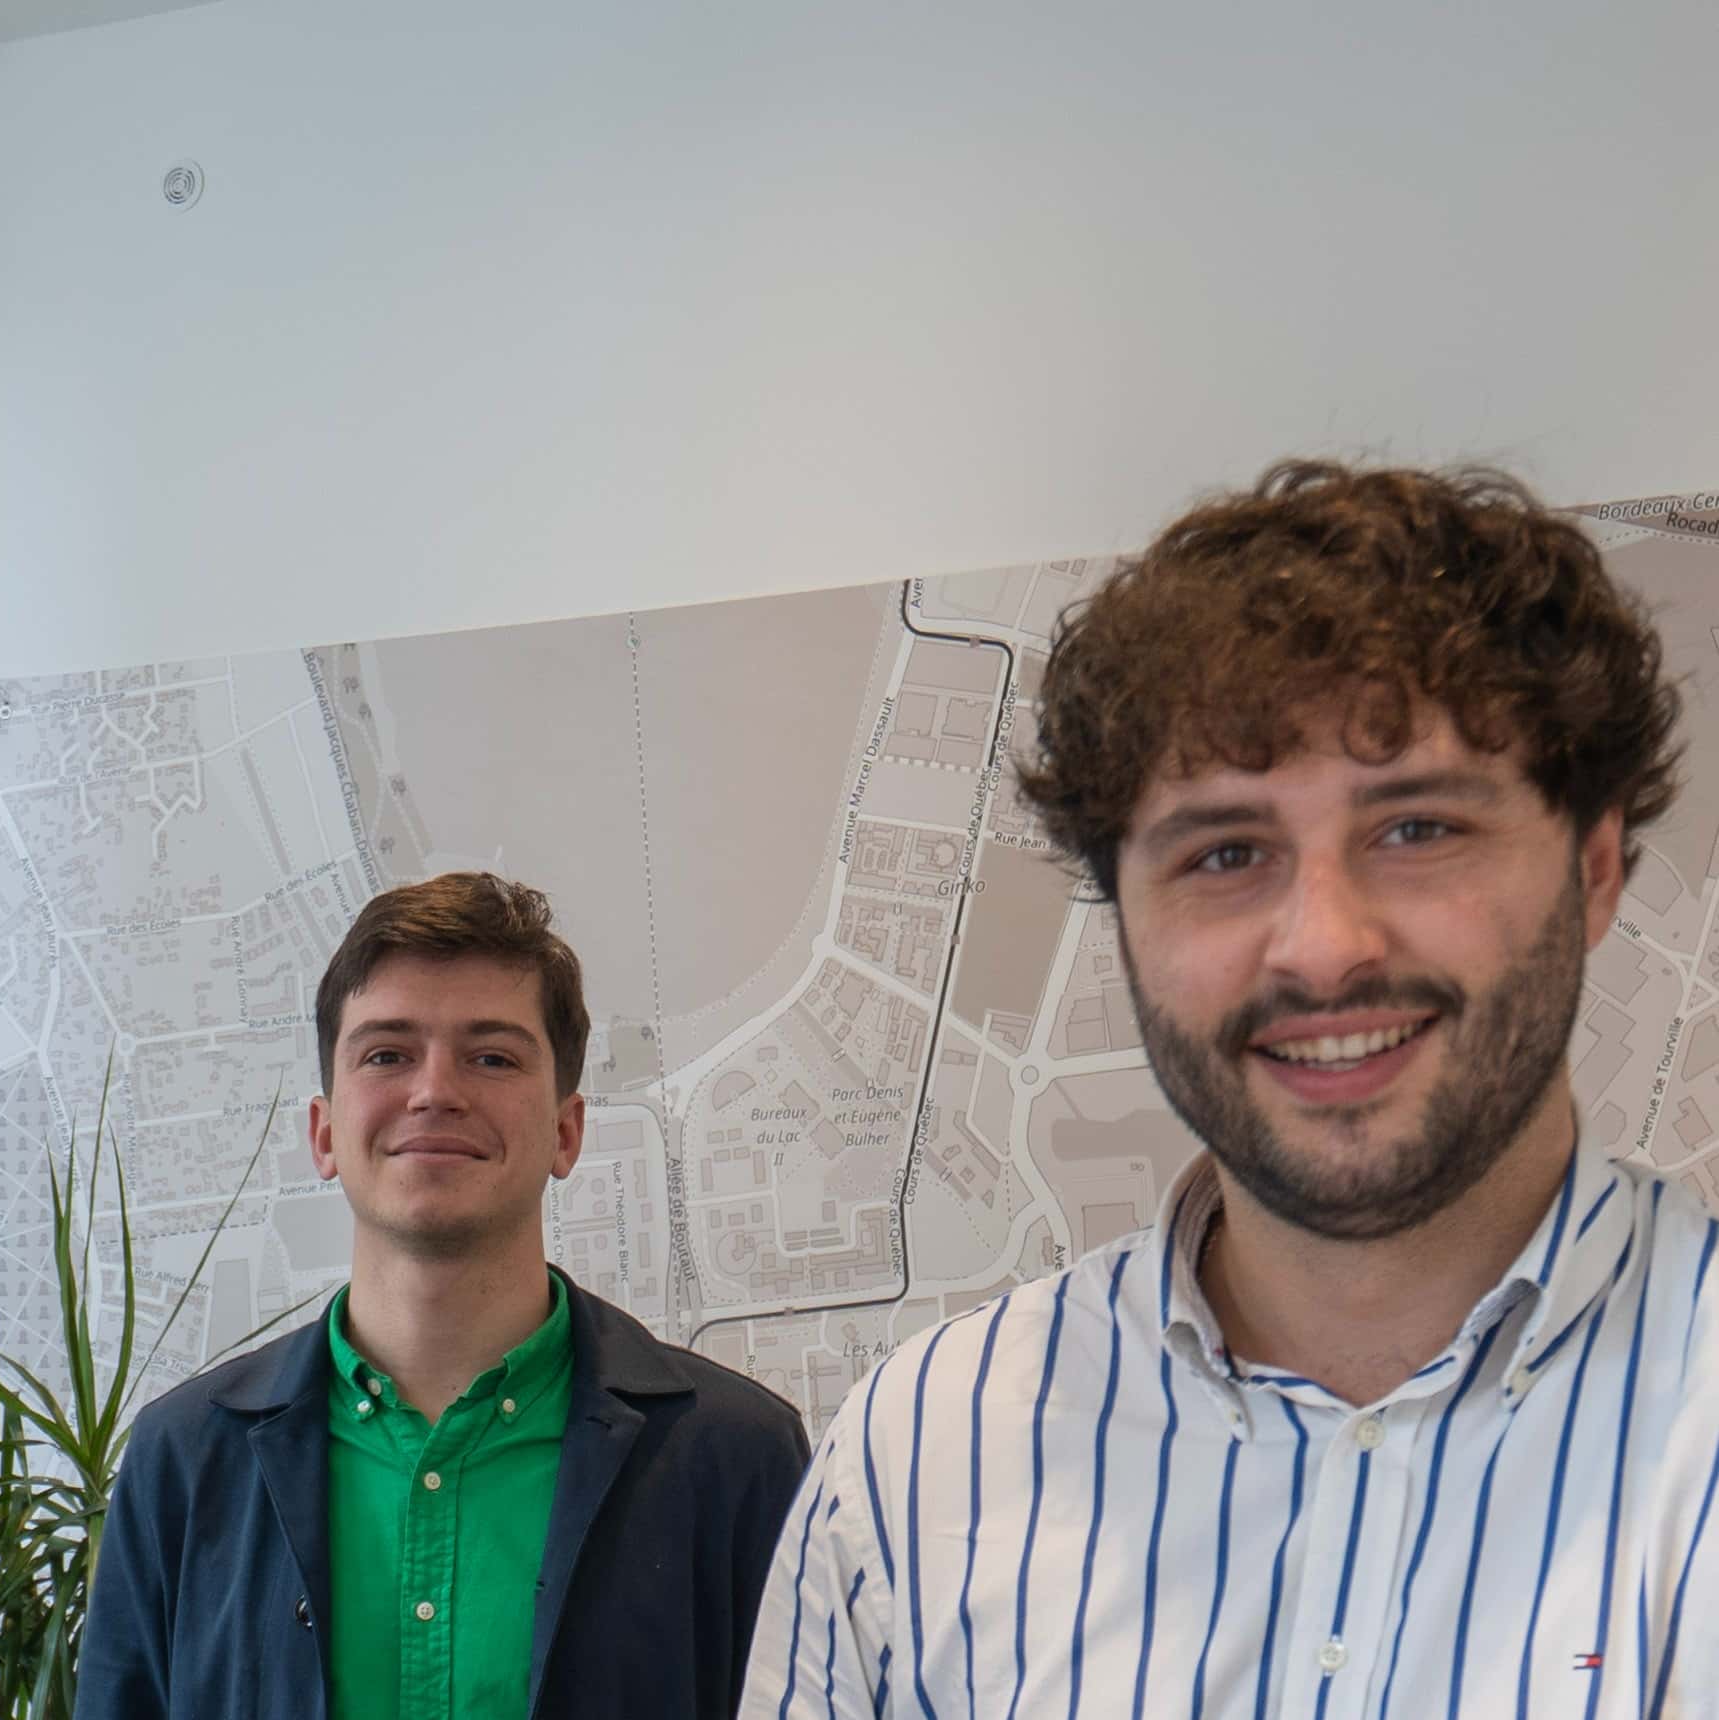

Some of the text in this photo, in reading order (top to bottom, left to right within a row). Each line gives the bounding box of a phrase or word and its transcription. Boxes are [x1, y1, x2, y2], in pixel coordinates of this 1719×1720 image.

[1599, 499, 1685, 520] Bordeaux
[989, 682, 1019, 792] Cours de Québec
[303, 651, 381, 894] Boulevard Jacques Chaban-Delmas
[839, 696, 895, 864] Avenue Marcel Dassault
[959, 767, 990, 877] Cours de Québec
[994, 831, 1047, 849] Rue Jean
[21, 857, 44, 899] Avenue
[39, 901, 53, 929] Jean
[265, 887, 284, 902] Rue
[286, 877, 305, 891] des
[330, 872, 351, 913] Avenue
[937, 878, 986, 896] Ginko
[107, 925, 127, 936] Rue
[129, 923, 147, 933] des
[231, 915, 241, 937] Rue
[249, 1017, 268, 1028] Rue
[831, 1085, 904, 1101] Parc Denis
[1636, 1016, 1684, 1150] Avenue de Tourville
[45, 1076, 64, 1120] Avenue
[751, 1107, 807, 1121] Bureaux
[834, 1112, 848, 1124] et
[757, 1131, 801, 1145] du Lac
[845, 1132, 890, 1147] Bulher
[905, 1096, 935, 1205] Cours de Québec
[669, 1157, 683, 1195] Allée
[280, 1182, 318, 1196] Avenue
[671, 1199, 683, 1219] de
[612, 1161, 629, 1282] Rue Théodore Blanc
[888, 1167, 906, 1277] Cours de Québec
[552, 1226, 563, 1241] de
[135, 1266, 153, 1279] Rue
[155, 1271, 187, 1288] Alfred
